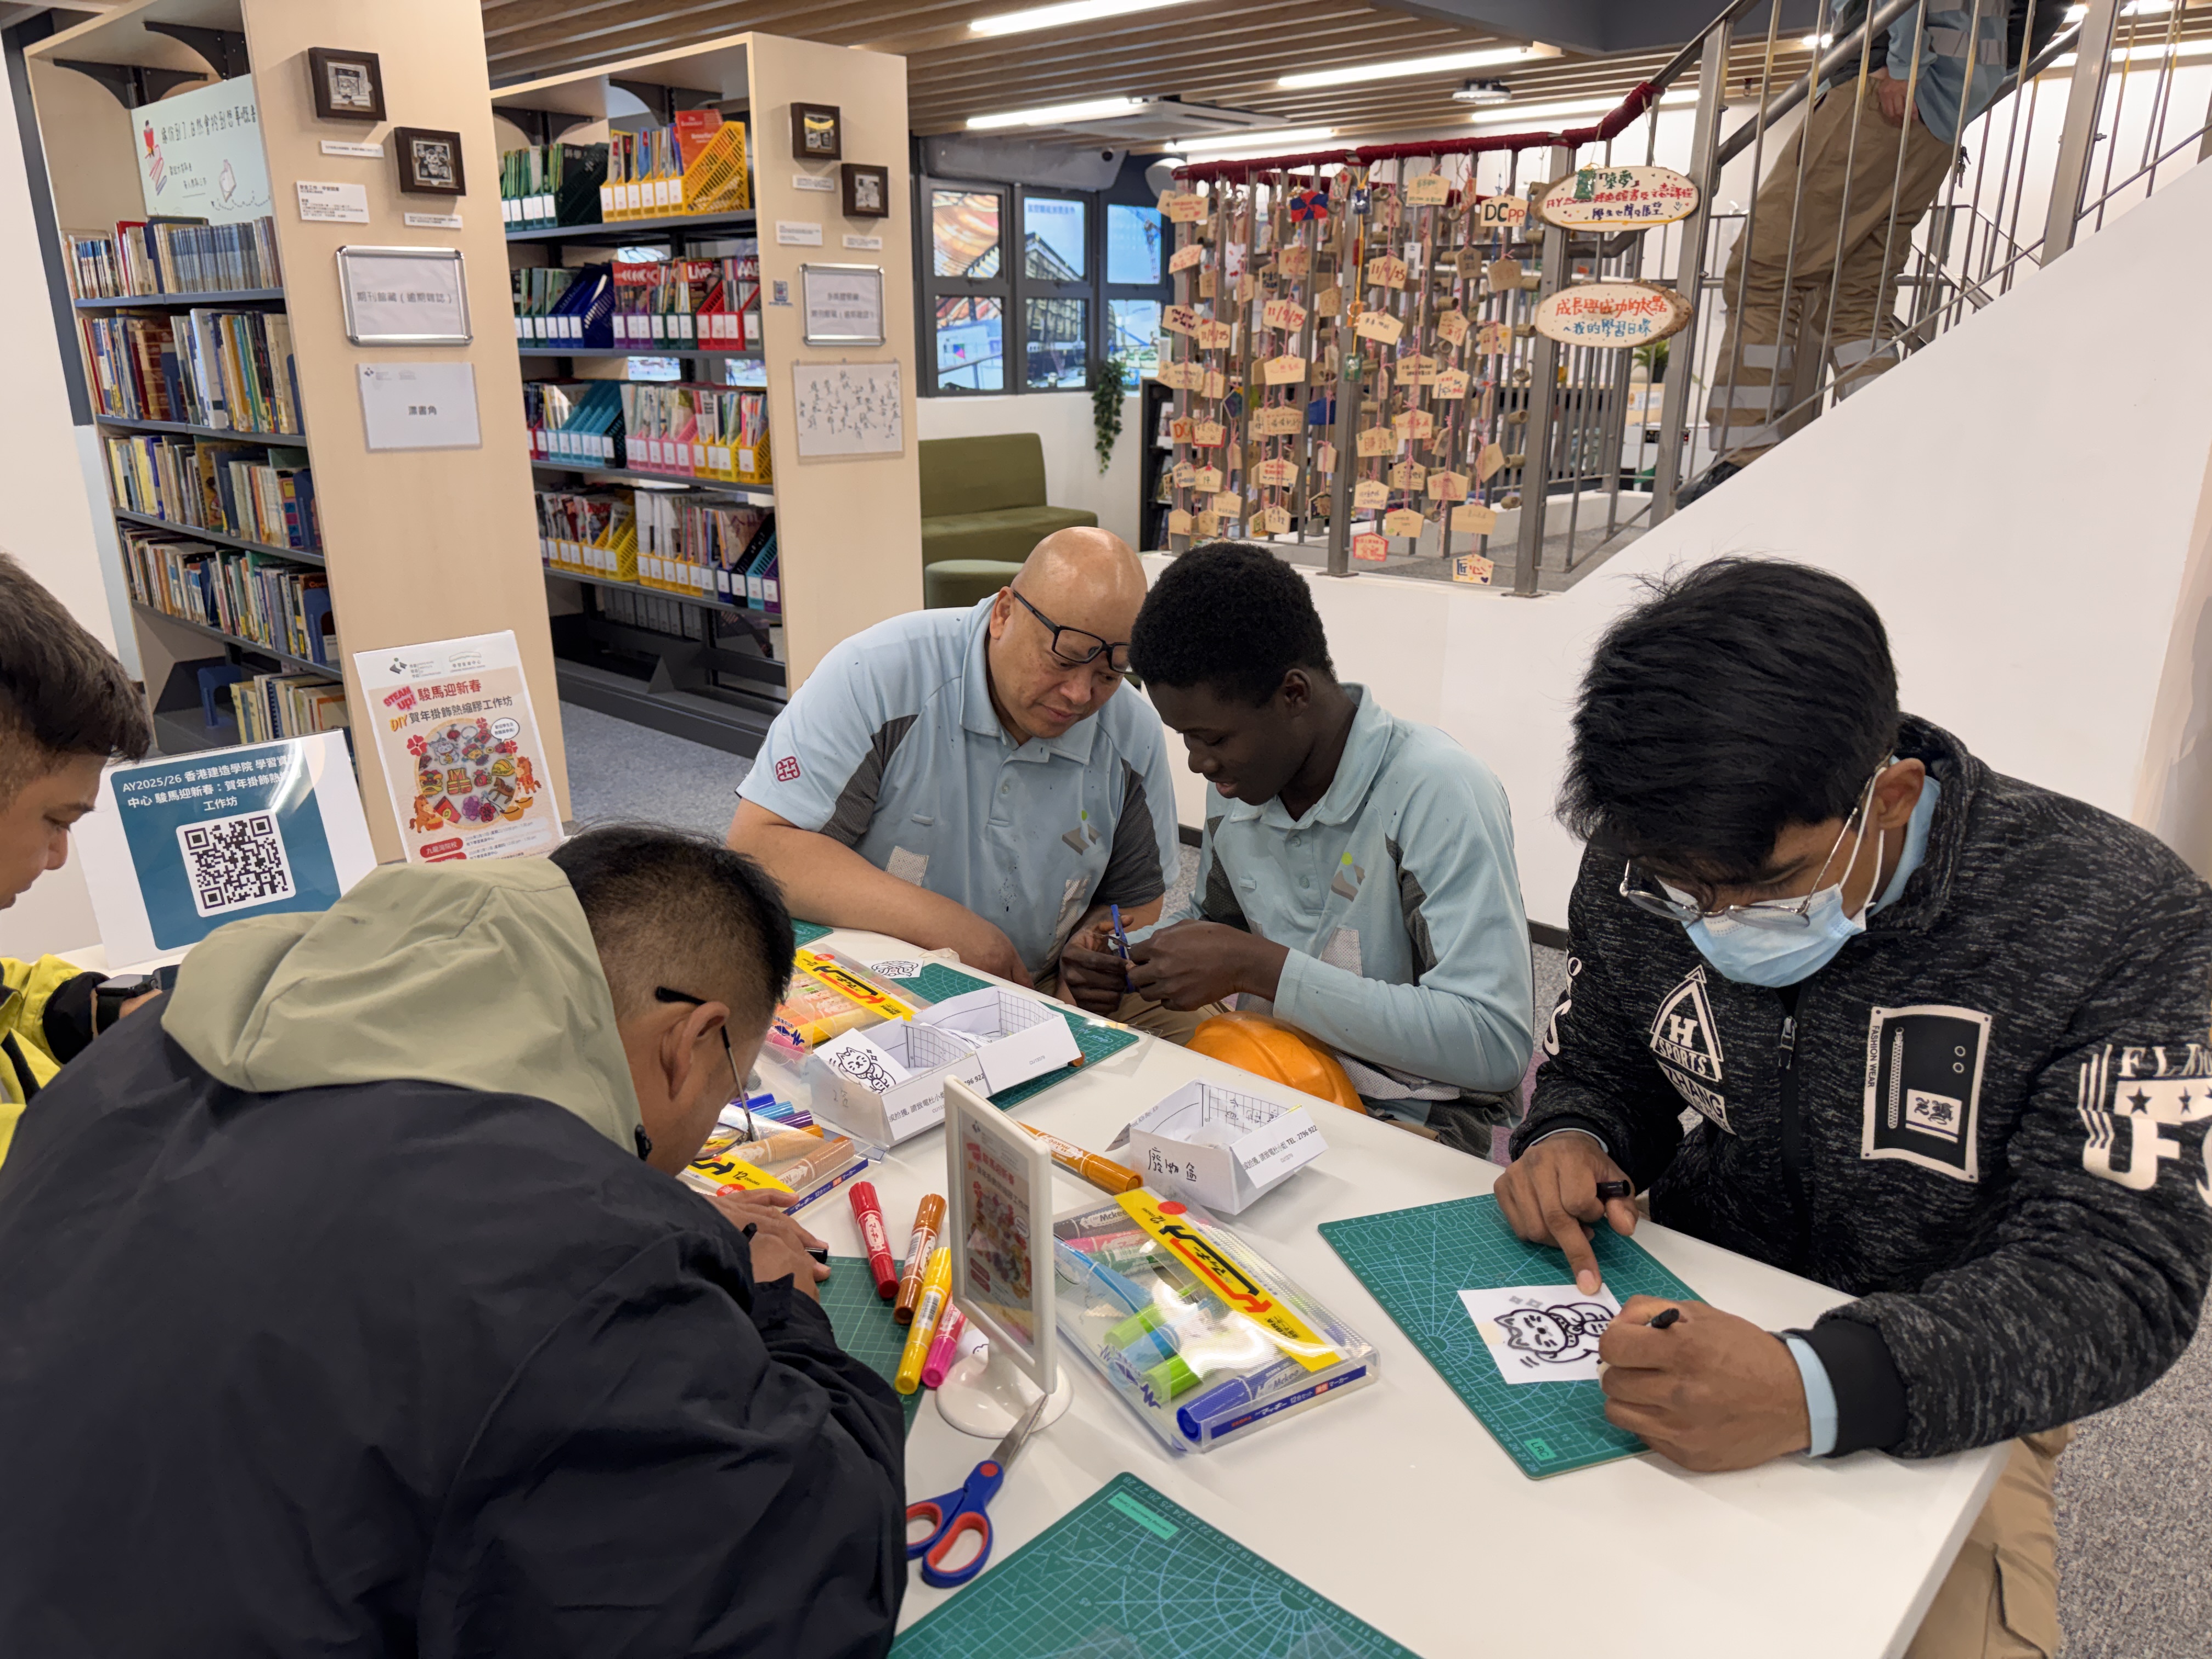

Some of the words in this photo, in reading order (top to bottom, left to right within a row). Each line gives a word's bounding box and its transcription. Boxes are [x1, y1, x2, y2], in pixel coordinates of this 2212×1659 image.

[417, 679, 481, 702] 駿馬迎新春
[384, 686, 411, 707] STEAM
[390, 714, 408, 731] DIY
[409, 696, 512, 724] 賀年掛飾熱縮膠工作坊
[122, 774, 182, 793] AY2025/26
[184, 760, 253, 782] 香港建造學院
[128, 795, 153, 808] 中心
[204, 796, 238, 811] 工作坊
[1669, 1014, 1698, 1049] H
[1870, 1025, 1881, 1062] FASHION
[1658, 1038, 1707, 1075] SPORTS
[1867, 1063, 1877, 1088] WEAR
[1663, 1064, 1724, 1120] ZHANG
[732, 1170, 745, 1181] 12
[1415, 1333, 1424, 1341] 14
[1430, 1350, 1438, 1358] 16
[1436, 1358, 1447, 1366] 17
[1444, 1366, 1454, 1375] 18
[1452, 1376, 1462, 1384] 19
[1459, 1385, 1470, 1393] 20
[1466, 1394, 1479, 1403] 21
[1475, 1404, 1487, 1413] 22
[1483, 1413, 1495, 1423] 23
[1491, 1421, 1503, 1432] 24
[1499, 1431, 1513, 1442] 25
[1508, 1441, 1521, 1452] 26
[1531, 1441, 1550, 1457] LRC
[1517, 1451, 1530, 1462] 27
[1526, 1461, 1539, 1472] 28
[1123, 1476, 1137, 1486] 28
[1134, 1485, 1147, 1494] 27
[1115, 1496, 1130, 1508] Centre
[1147, 1493, 1161, 1502] 26
[1161, 1500, 1174, 1509] 25
[1172, 1509, 1187, 1519] 24
[1153, 1519, 1172, 1534] Learning
[1186, 1517, 1200, 1527] 23
[1199, 1525, 1213, 1535] 22
[1212, 1534, 1226, 1544] 21
[1226, 1543, 1242, 1553] 20
[1240, 1552, 1253, 1562] 19
[1254, 1556, 1267, 1570] 18
[1267, 1570, 1282, 1579] 17
[1282, 1578, 1296, 1589] 16
[1299, 1588, 1311, 1598] 15
[1312, 1597, 1325, 1607] 14
[1326, 1606, 1341, 1617] 13
[1342, 1617, 1356, 1628] 12
[1357, 1626, 1373, 1637] 11
[1373, 1635, 1388, 1646] 10
[1392, 1647, 1402, 1656] 9
